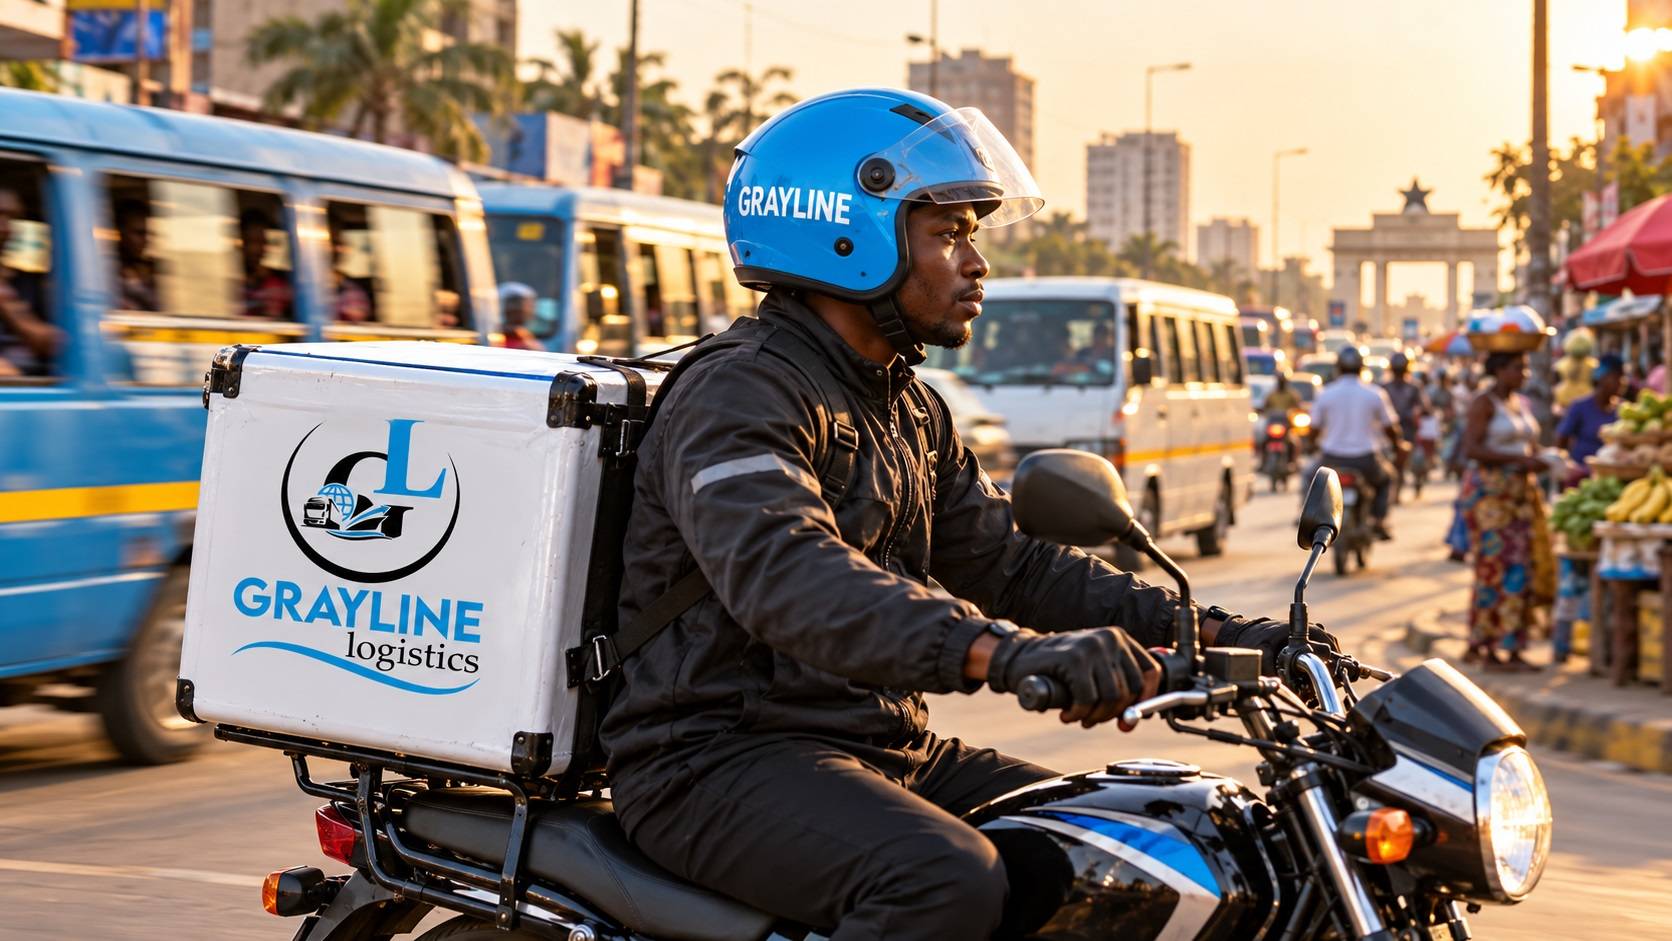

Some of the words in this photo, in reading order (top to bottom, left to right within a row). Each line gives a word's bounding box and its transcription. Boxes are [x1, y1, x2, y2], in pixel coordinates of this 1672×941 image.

[738, 185, 853, 225] GRAYLINE
[233, 576, 485, 644] GRAYLINE
[345, 631, 480, 674] logistics
